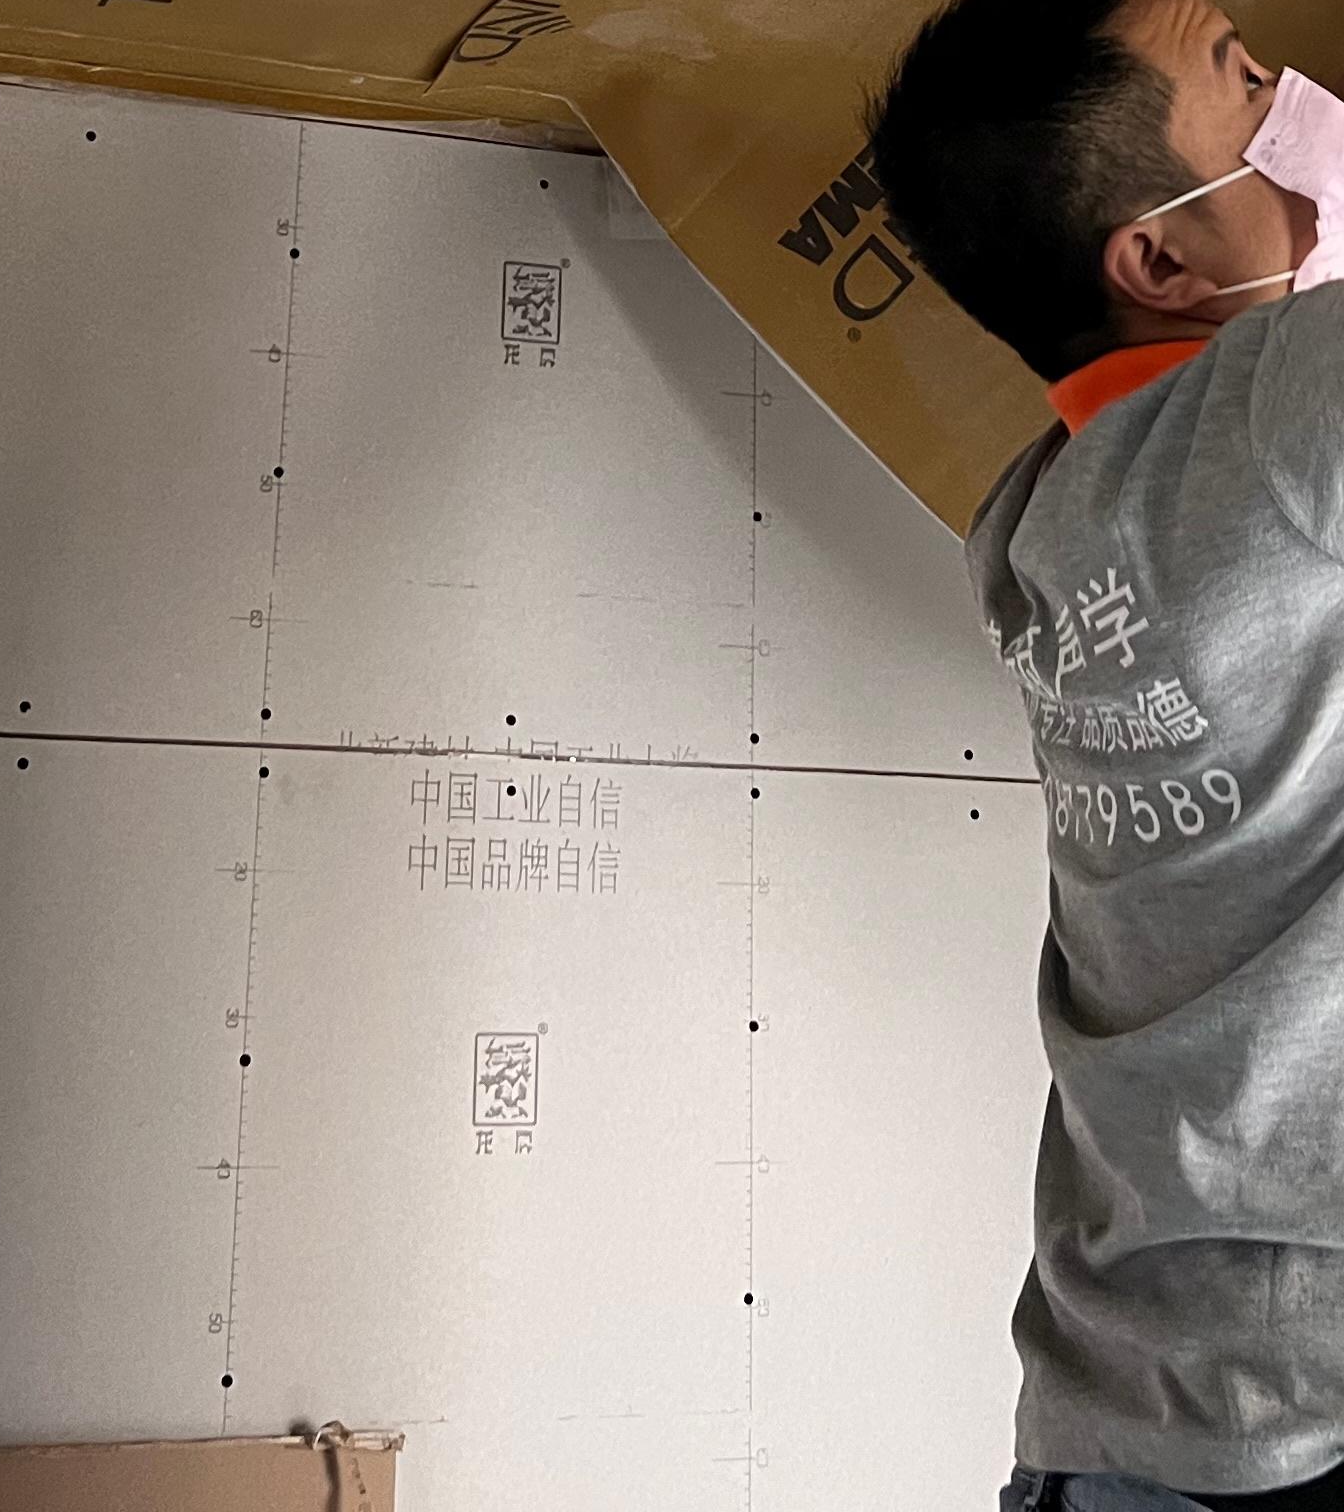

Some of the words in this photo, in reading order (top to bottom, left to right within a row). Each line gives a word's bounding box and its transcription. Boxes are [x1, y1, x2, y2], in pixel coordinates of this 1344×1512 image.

[410, 769, 623, 830] 中国工业自信
[408, 834, 622, 895] 中国品牌自信
[225, 1007, 240, 1029] 30
[208, 1312, 223, 1334] 50
